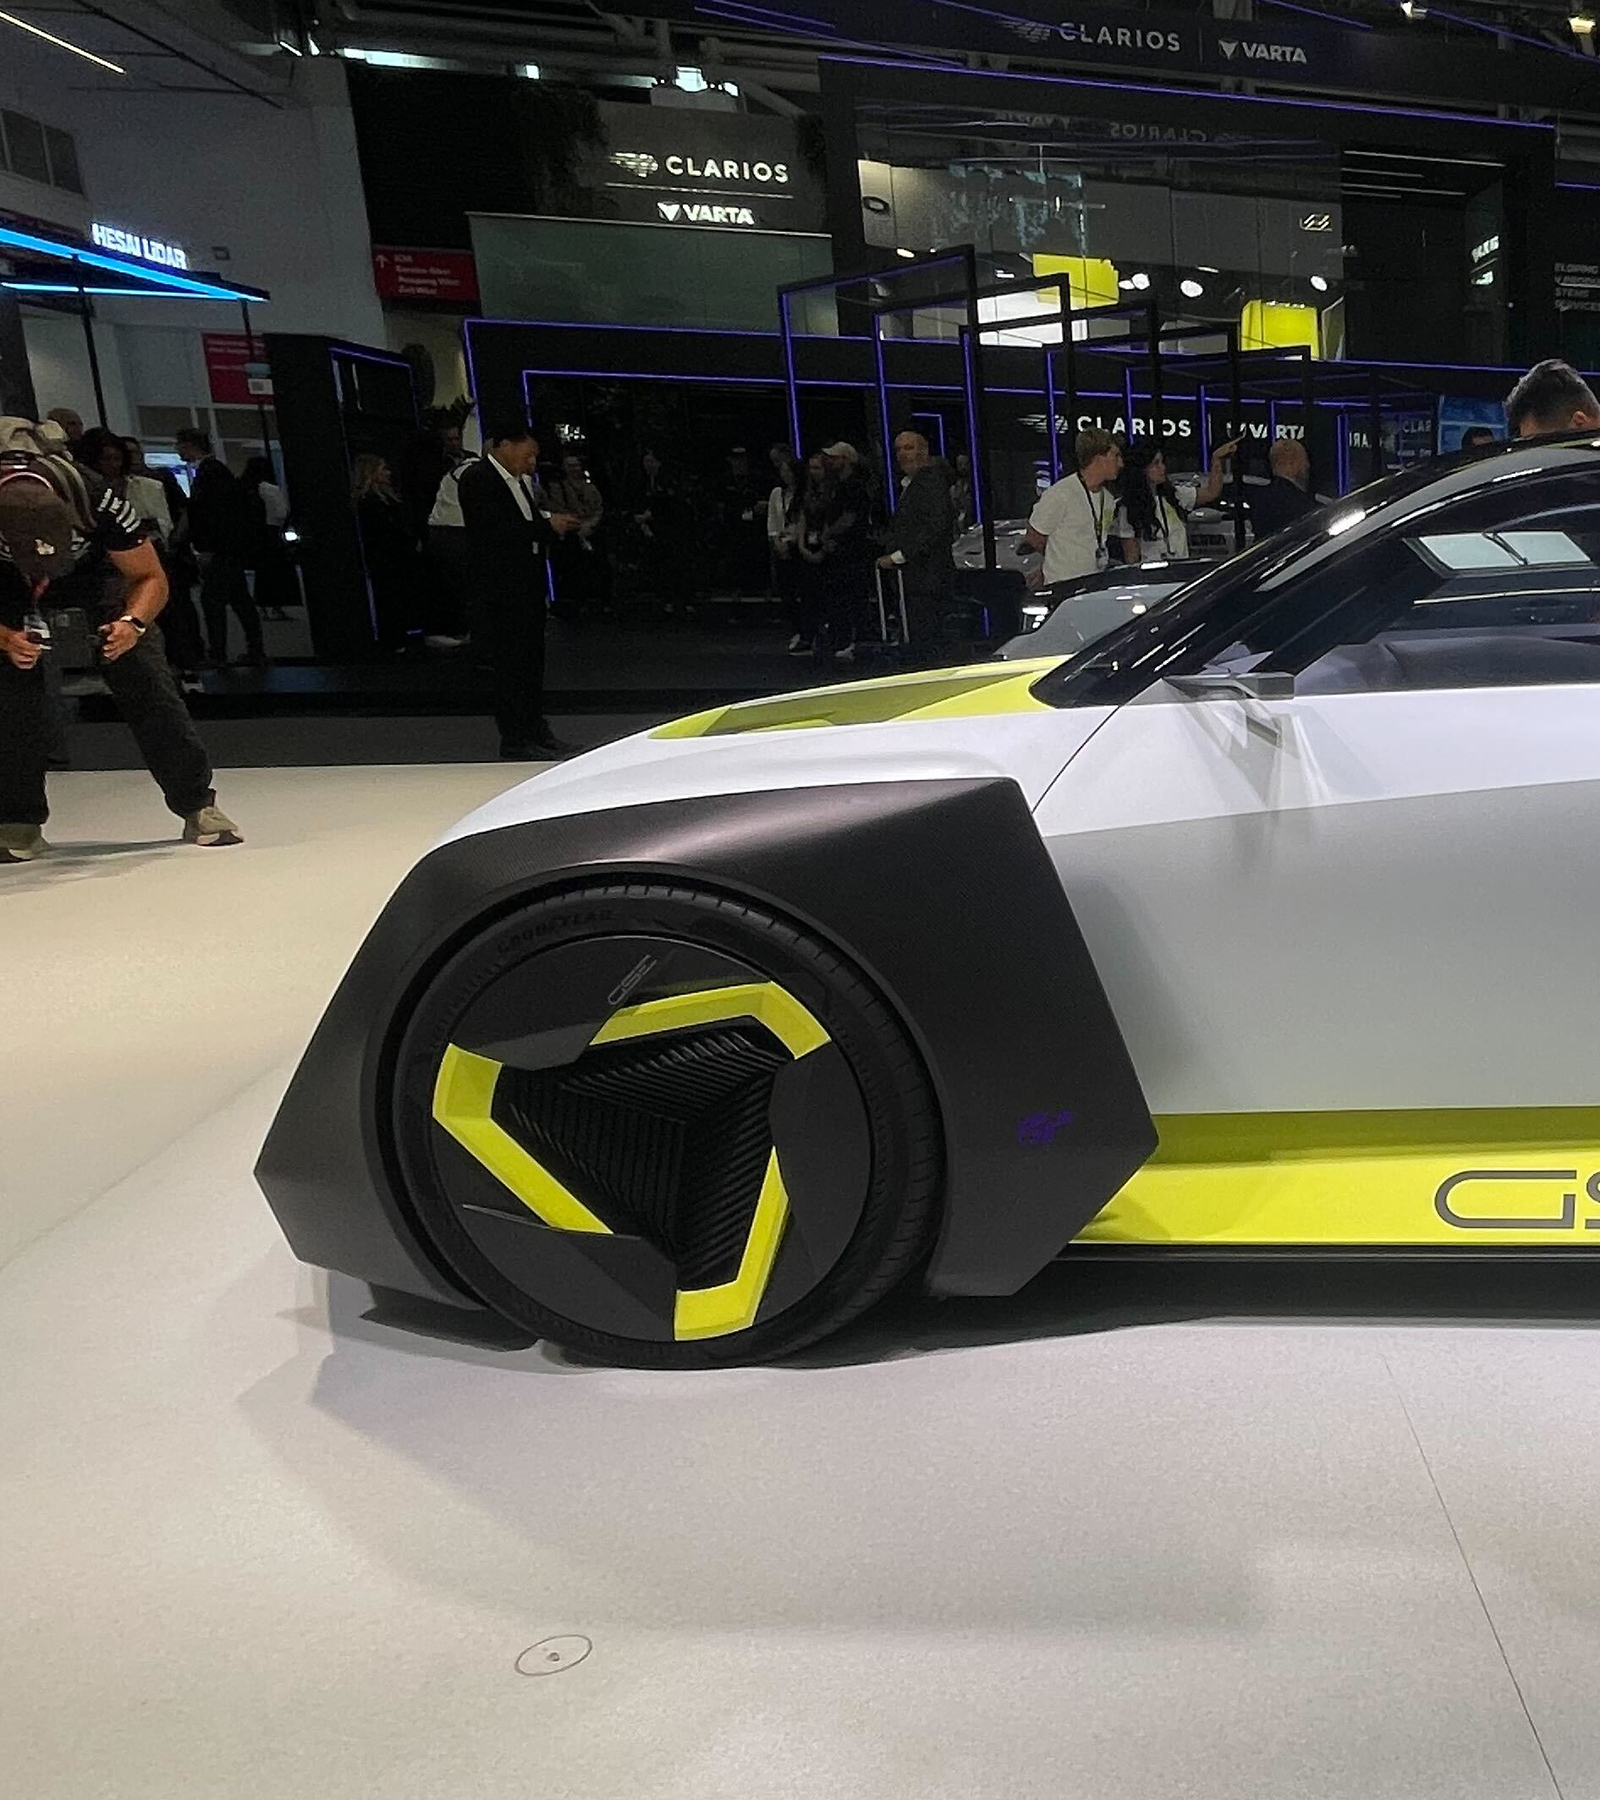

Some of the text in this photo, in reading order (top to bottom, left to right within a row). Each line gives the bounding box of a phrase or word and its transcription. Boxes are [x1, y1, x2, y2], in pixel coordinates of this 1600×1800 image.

[1060, 22, 1180, 51] CLARIOS
[1242, 41, 1307, 64] VARTA
[665, 155, 789, 183] CLARIOS
[682, 204, 755, 225] VARTA
[92, 222, 141, 257] HESAI
[1077, 415, 1191, 437] CLARIOS
